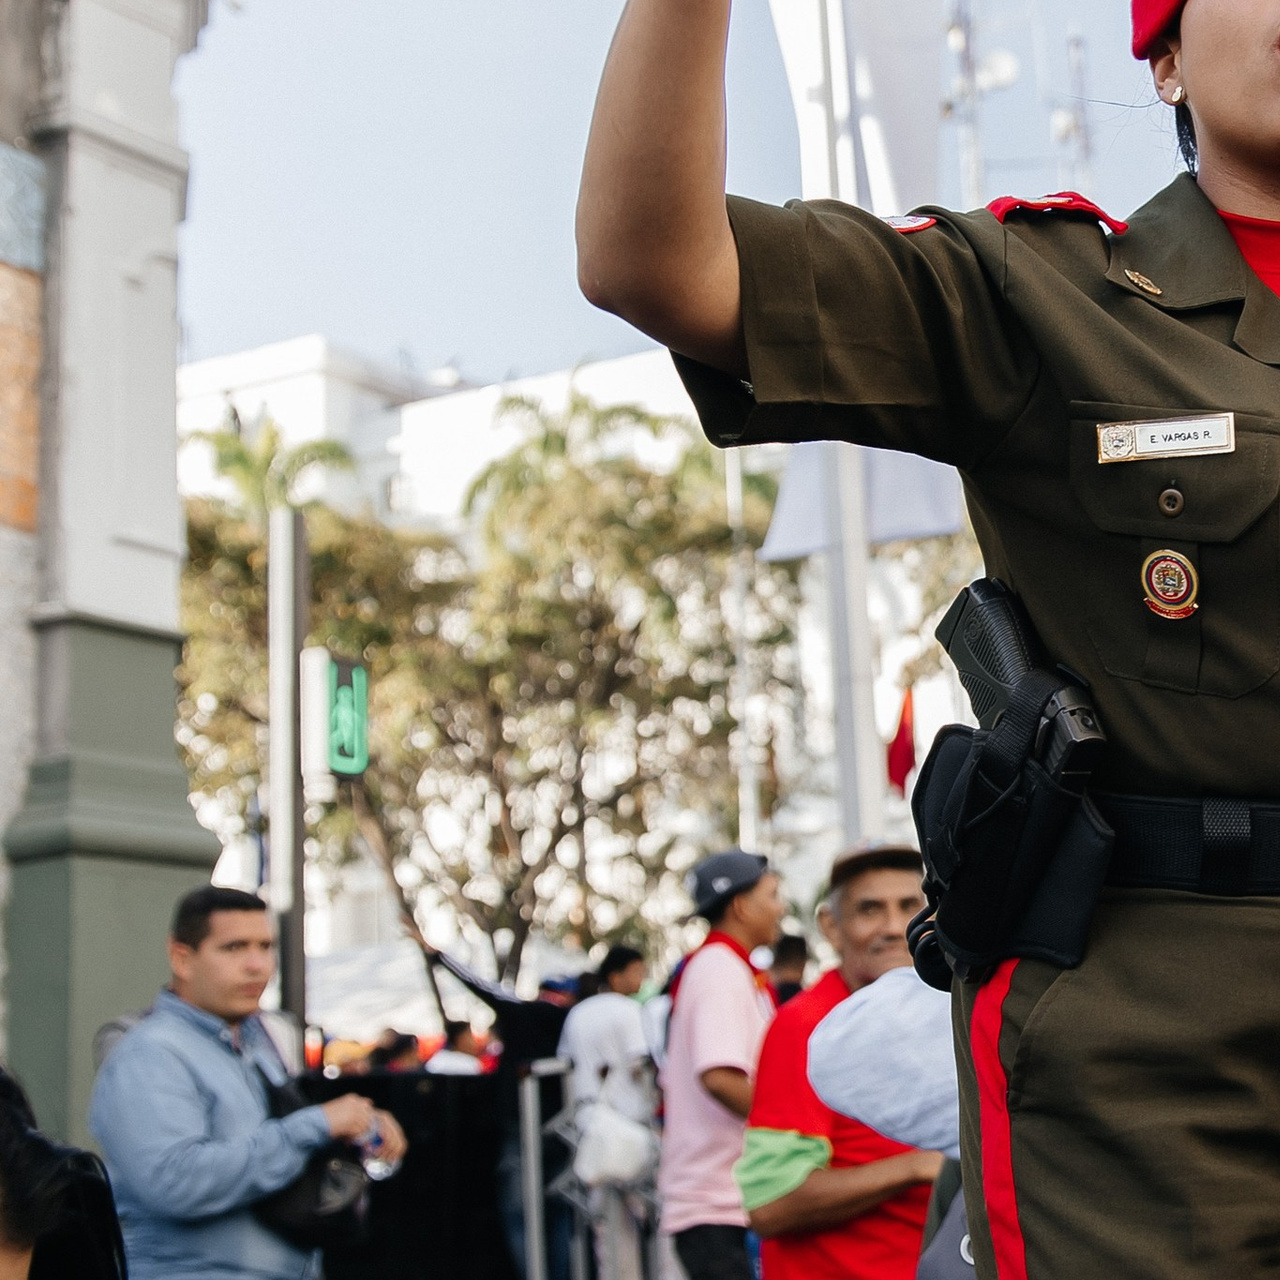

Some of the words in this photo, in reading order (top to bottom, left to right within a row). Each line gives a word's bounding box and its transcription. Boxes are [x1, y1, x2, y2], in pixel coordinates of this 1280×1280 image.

[1150, 435, 1158, 443] E.
[1161, 431, 1199, 442] VARGAS
[1203, 431, 1212, 439] R.
